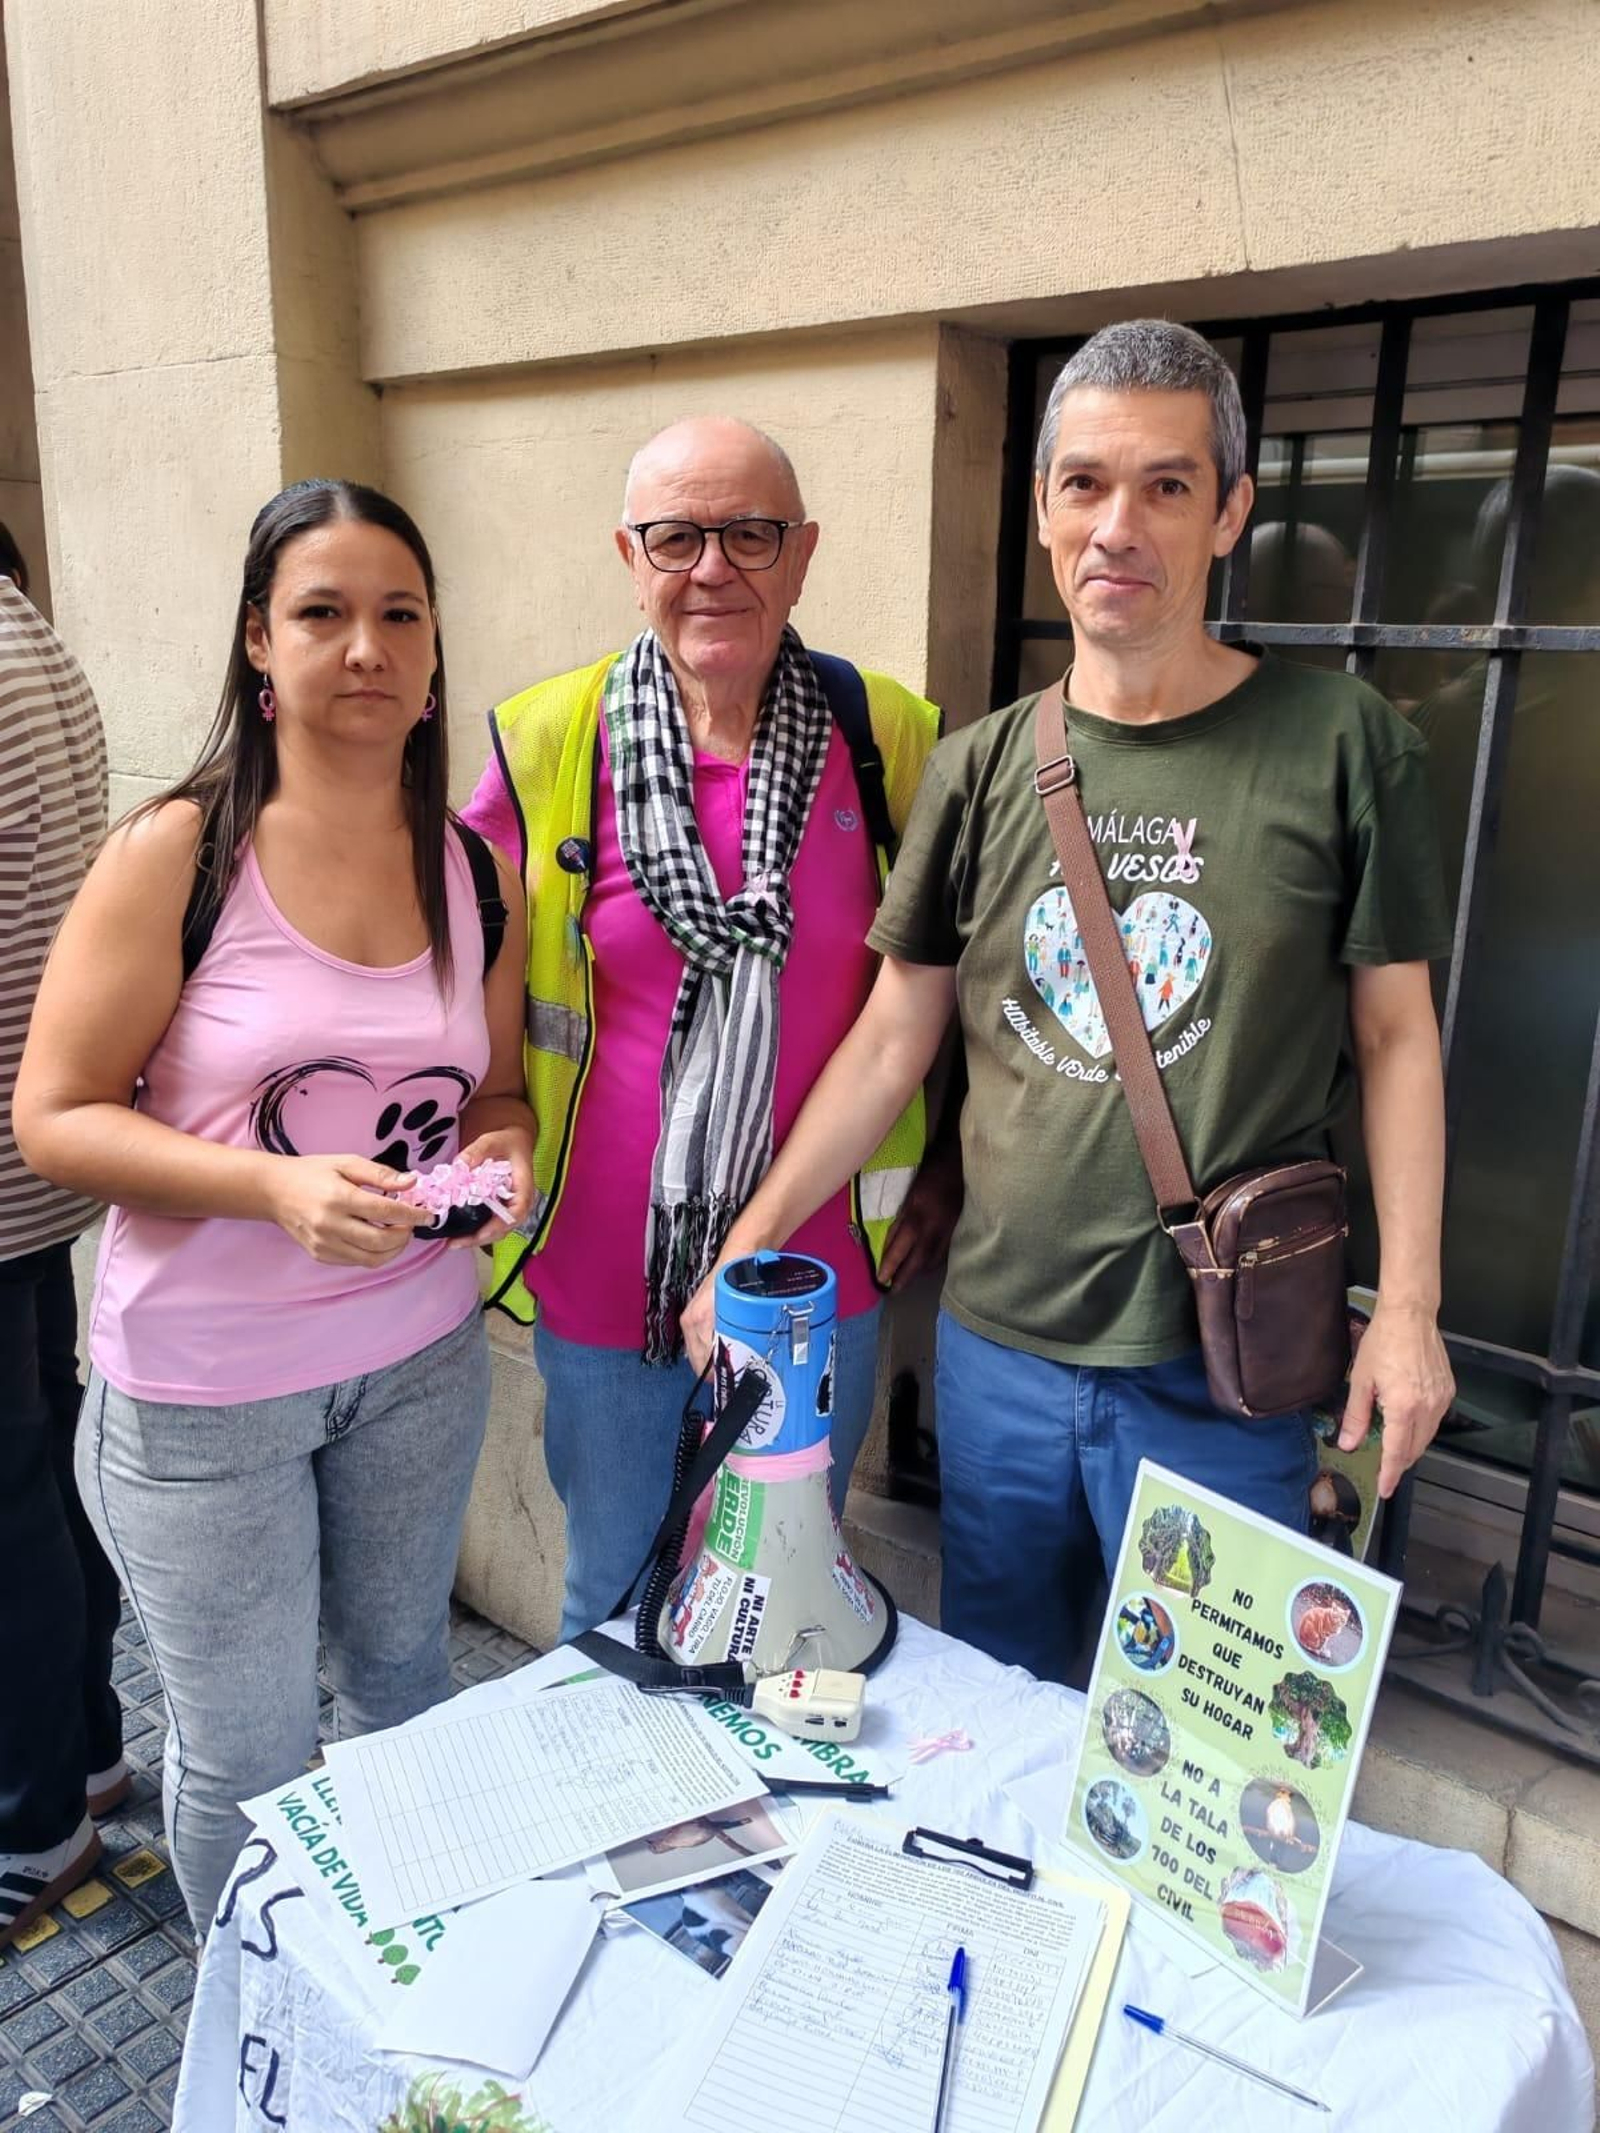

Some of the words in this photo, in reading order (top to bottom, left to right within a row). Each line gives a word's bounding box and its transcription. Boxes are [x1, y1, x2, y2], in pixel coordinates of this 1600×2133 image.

[1087, 808, 1178, 845] MÁLAGA
[1155, 1017, 1212, 1069] tenible
[718, 1471, 741, 1555] ERDE
[703, 1590, 716, 1608] DEL
[743, 1577, 756, 1594] NI
[752, 1594, 765, 1612] NI
[1232, 1588, 1254, 1610] NO
[688, 1608, 708, 1639] CARRO
[727, 1598, 751, 1663] CULTURA
[741, 1615, 760, 1655] ARTE
[1191, 1599, 1285, 1660] PERMITAMOS
[1212, 1642, 1243, 1669] QUE
[1178, 1653, 1266, 1716] DESTRUYAN
[702, 1696, 783, 1760] NEMOS
[1181, 1687, 1200, 1707] SU
[1203, 1699, 1254, 1741] HOGAR
[1182, 1759, 1204, 1783] NO
[1208, 1778, 1221, 1798] A
[1160, 1781, 1182, 1808] LA
[1188, 1797, 1228, 1839] TALA
[277, 1791, 330, 1851] VACÍA
[312, 1846, 348, 1878] DE
[331, 1872, 369, 1928] VIDA
[1160, 1816, 1183, 1842] DE
[1186, 1831, 1217, 1866] LOS
[1151, 1844, 1179, 1874] 700
[1183, 1867, 1214, 1901] DEL
[1157, 1883, 1195, 1923] CIVIL
